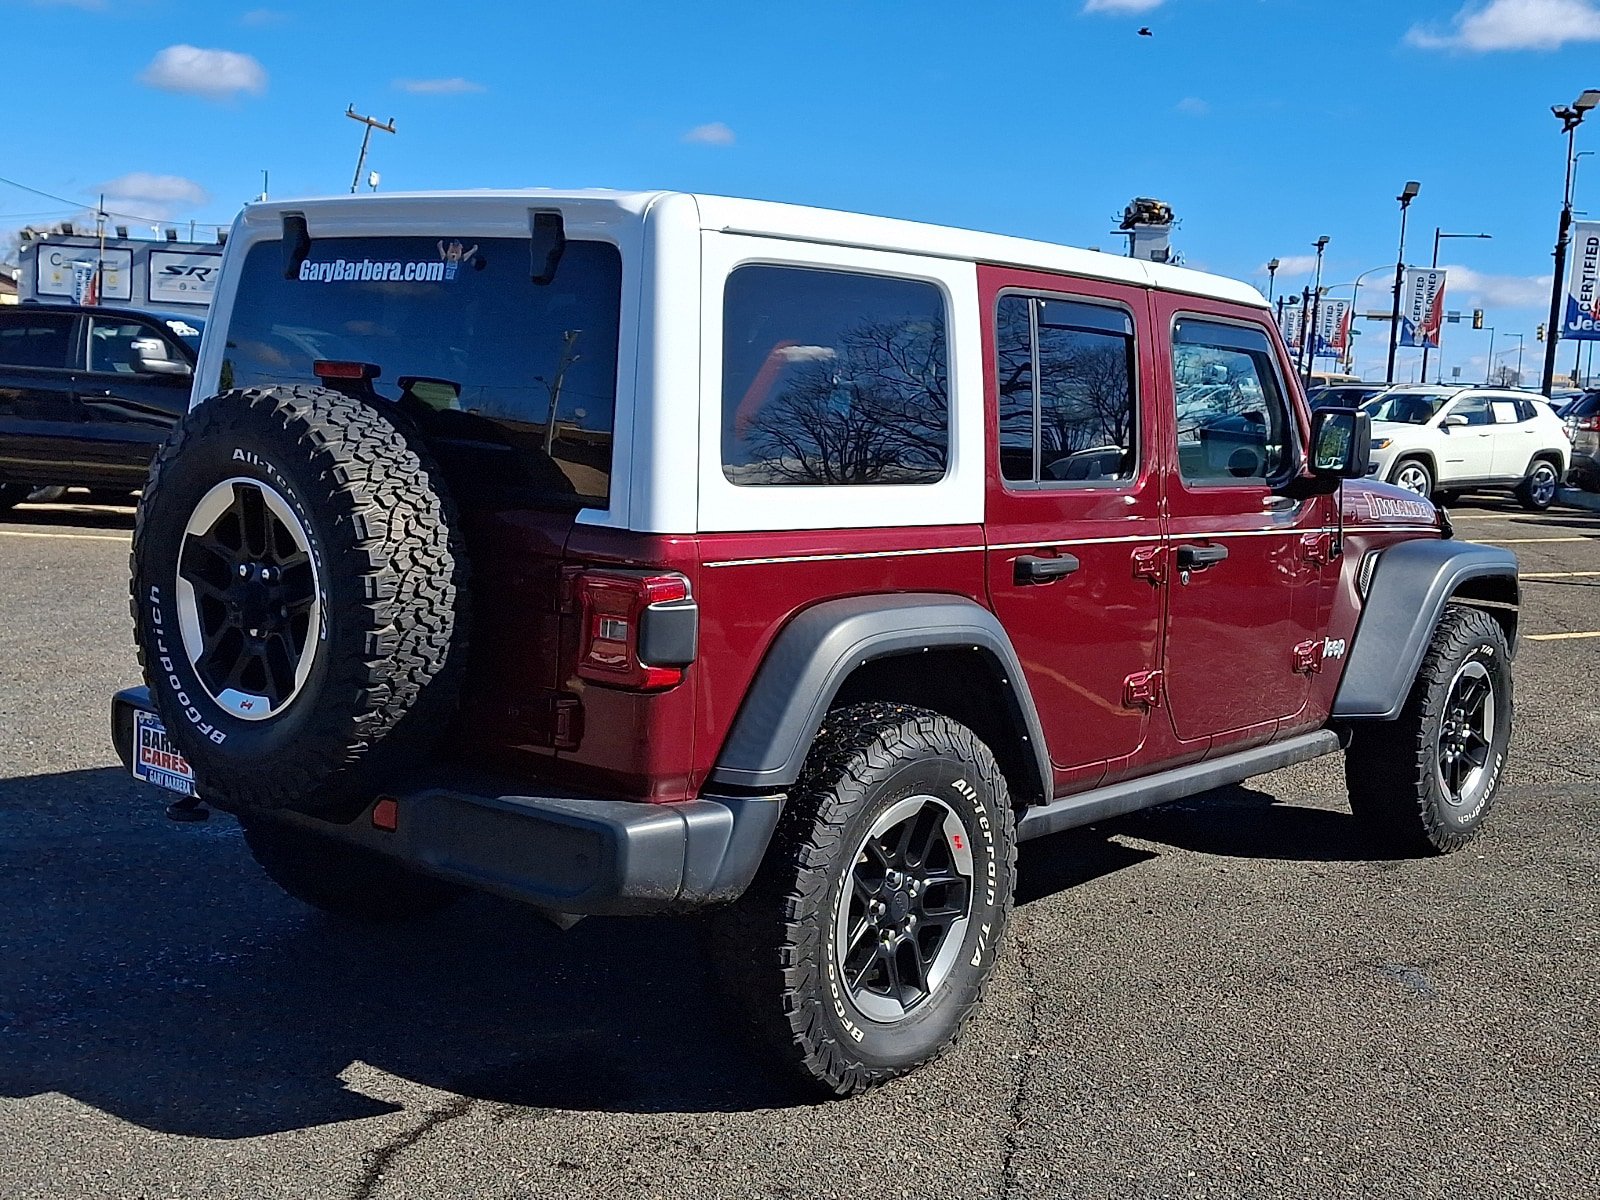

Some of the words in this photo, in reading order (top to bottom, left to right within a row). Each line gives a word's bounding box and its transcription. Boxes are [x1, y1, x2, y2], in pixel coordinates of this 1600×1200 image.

[159, 265, 219, 282] SR
[299, 259, 444, 283] GaryBarbera.com
[1580, 236, 1600, 313] CERTIFIED
[1413, 276, 1425, 322] CERTIFIED
[1425, 273, 1437, 324] PRE-OWNED
[150, 585, 227, 744] BFGoodrich
[1323, 636, 1345, 659] Jeep
[142, 747, 190, 775] CARES
[951, 777, 999, 906] All-Terrain
[969, 922, 993, 967] T/A
